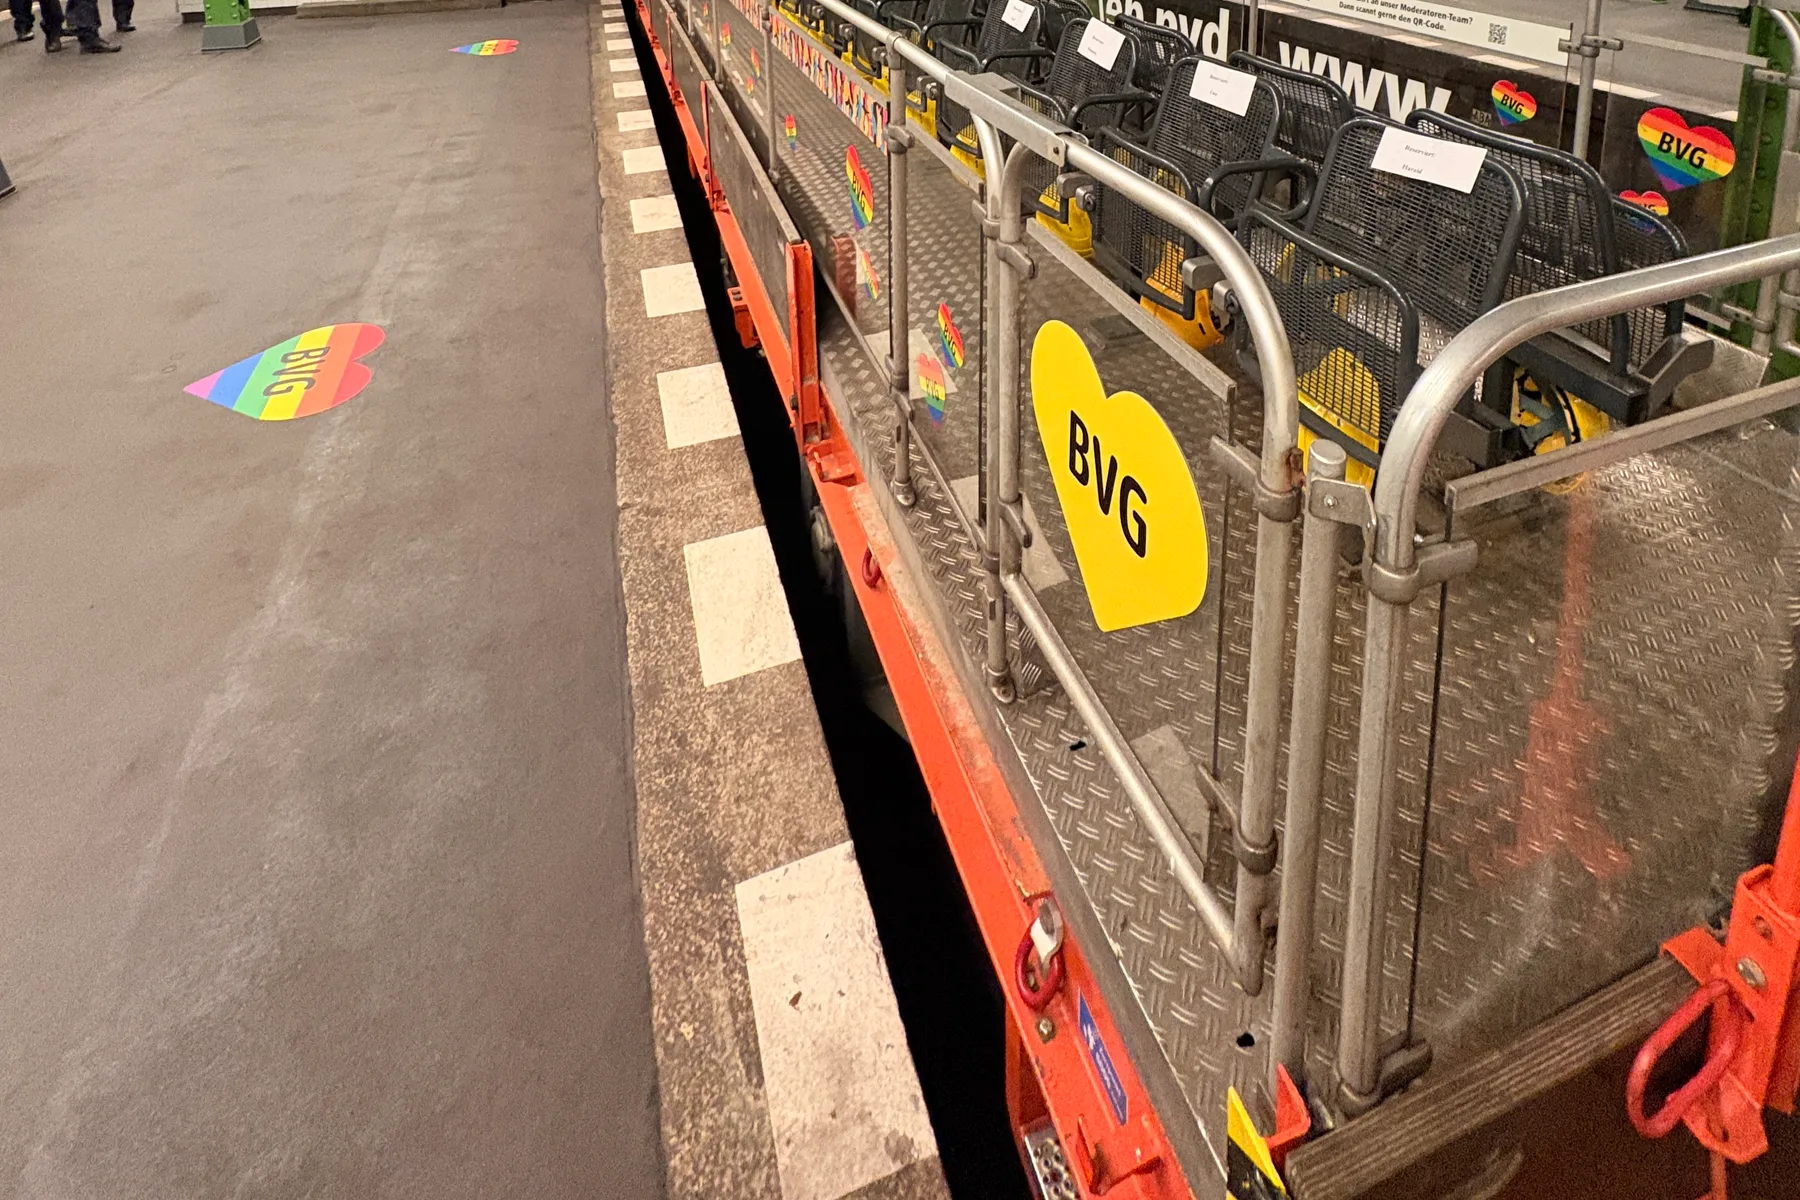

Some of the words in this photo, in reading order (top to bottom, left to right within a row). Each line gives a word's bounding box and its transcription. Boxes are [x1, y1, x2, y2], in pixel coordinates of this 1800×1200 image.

[1339, 1, 1354, 10] Dann
[1355, 5, 1376, 16] scannt
[1377, 9, 1397, 20] gerne
[1398, 13, 1411, 24] den
[1413, 17, 1446, 32] QR-Code.
[1380, 0, 1398, 10] unser
[1400, 3, 1473, 25] Moderatoren-Team?
[1500, 93, 1525, 116] BVG
[1657, 131, 1708, 170] BVG
[852, 171, 866, 213] BVG
[262, 346, 331, 397] BVG
[1069, 409, 1147, 559] BVG
